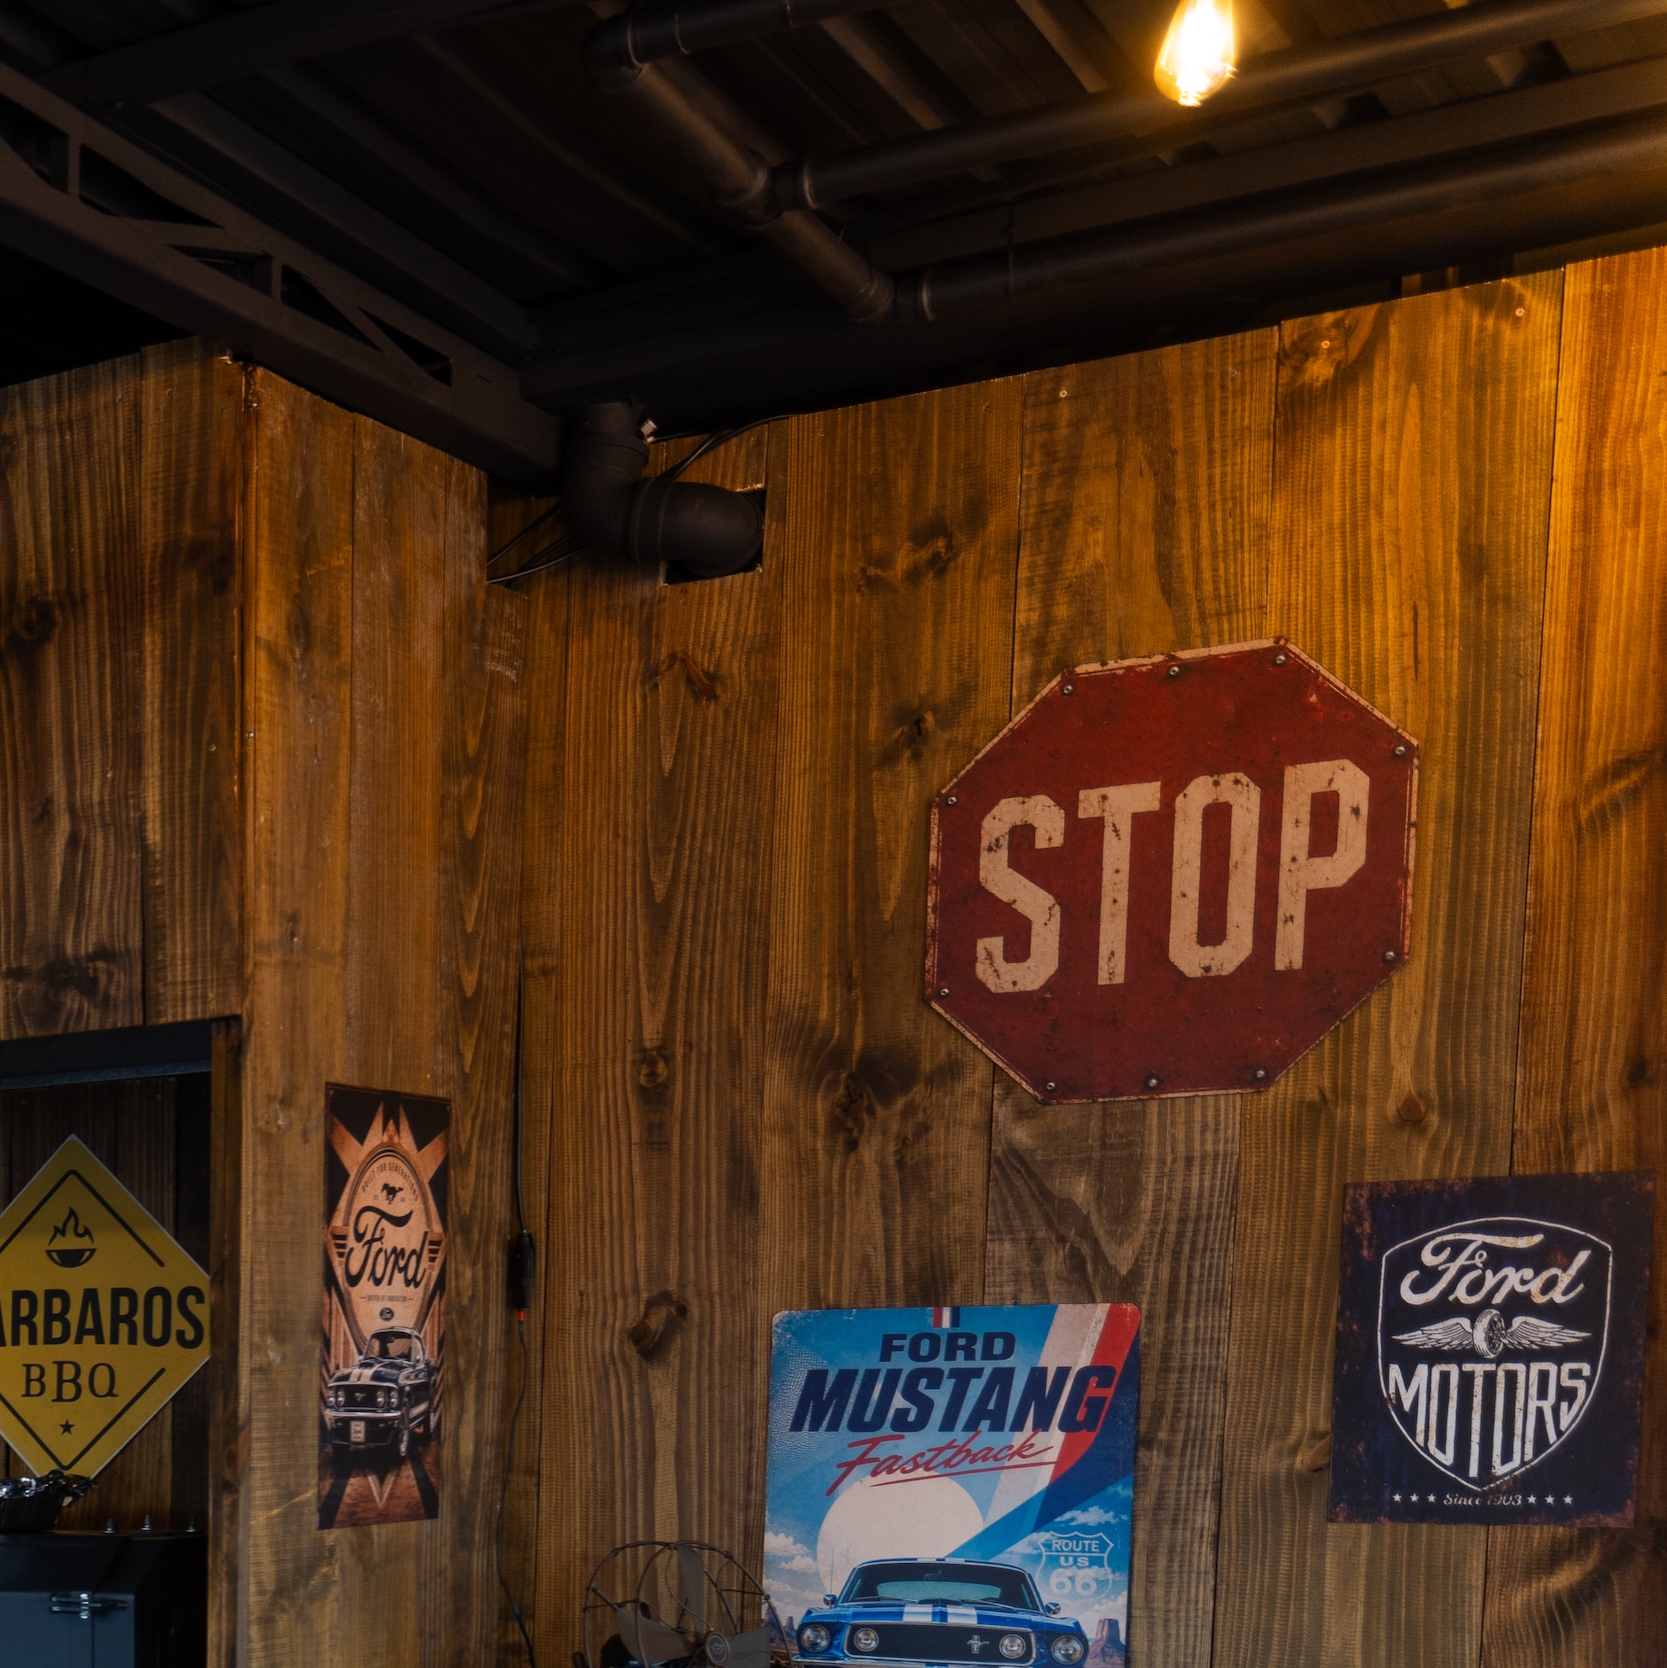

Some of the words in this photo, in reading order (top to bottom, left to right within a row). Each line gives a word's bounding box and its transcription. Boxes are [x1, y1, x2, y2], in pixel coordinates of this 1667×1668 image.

[975, 758, 1371, 994] STOP
[345, 1205, 429, 1289] Ford
[1400, 1232, 1592, 1305] Ford
[879, 1331, 1017, 1363] FORD
[20, 1360, 119, 1404] BBQ
[789, 1365, 1118, 1433] MUSTANG
[1388, 1361, 1592, 1478] MOTORS
[825, 1428, 1056, 1497] Fastback
[1443, 1493, 1482, 1505] Since
[1487, 1493, 1522, 1506] 1903
[1052, 1540, 1100, 1552] ROUTE
[1059, 1556, 1090, 1567] US
[1050, 1568, 1097, 1596] 66
